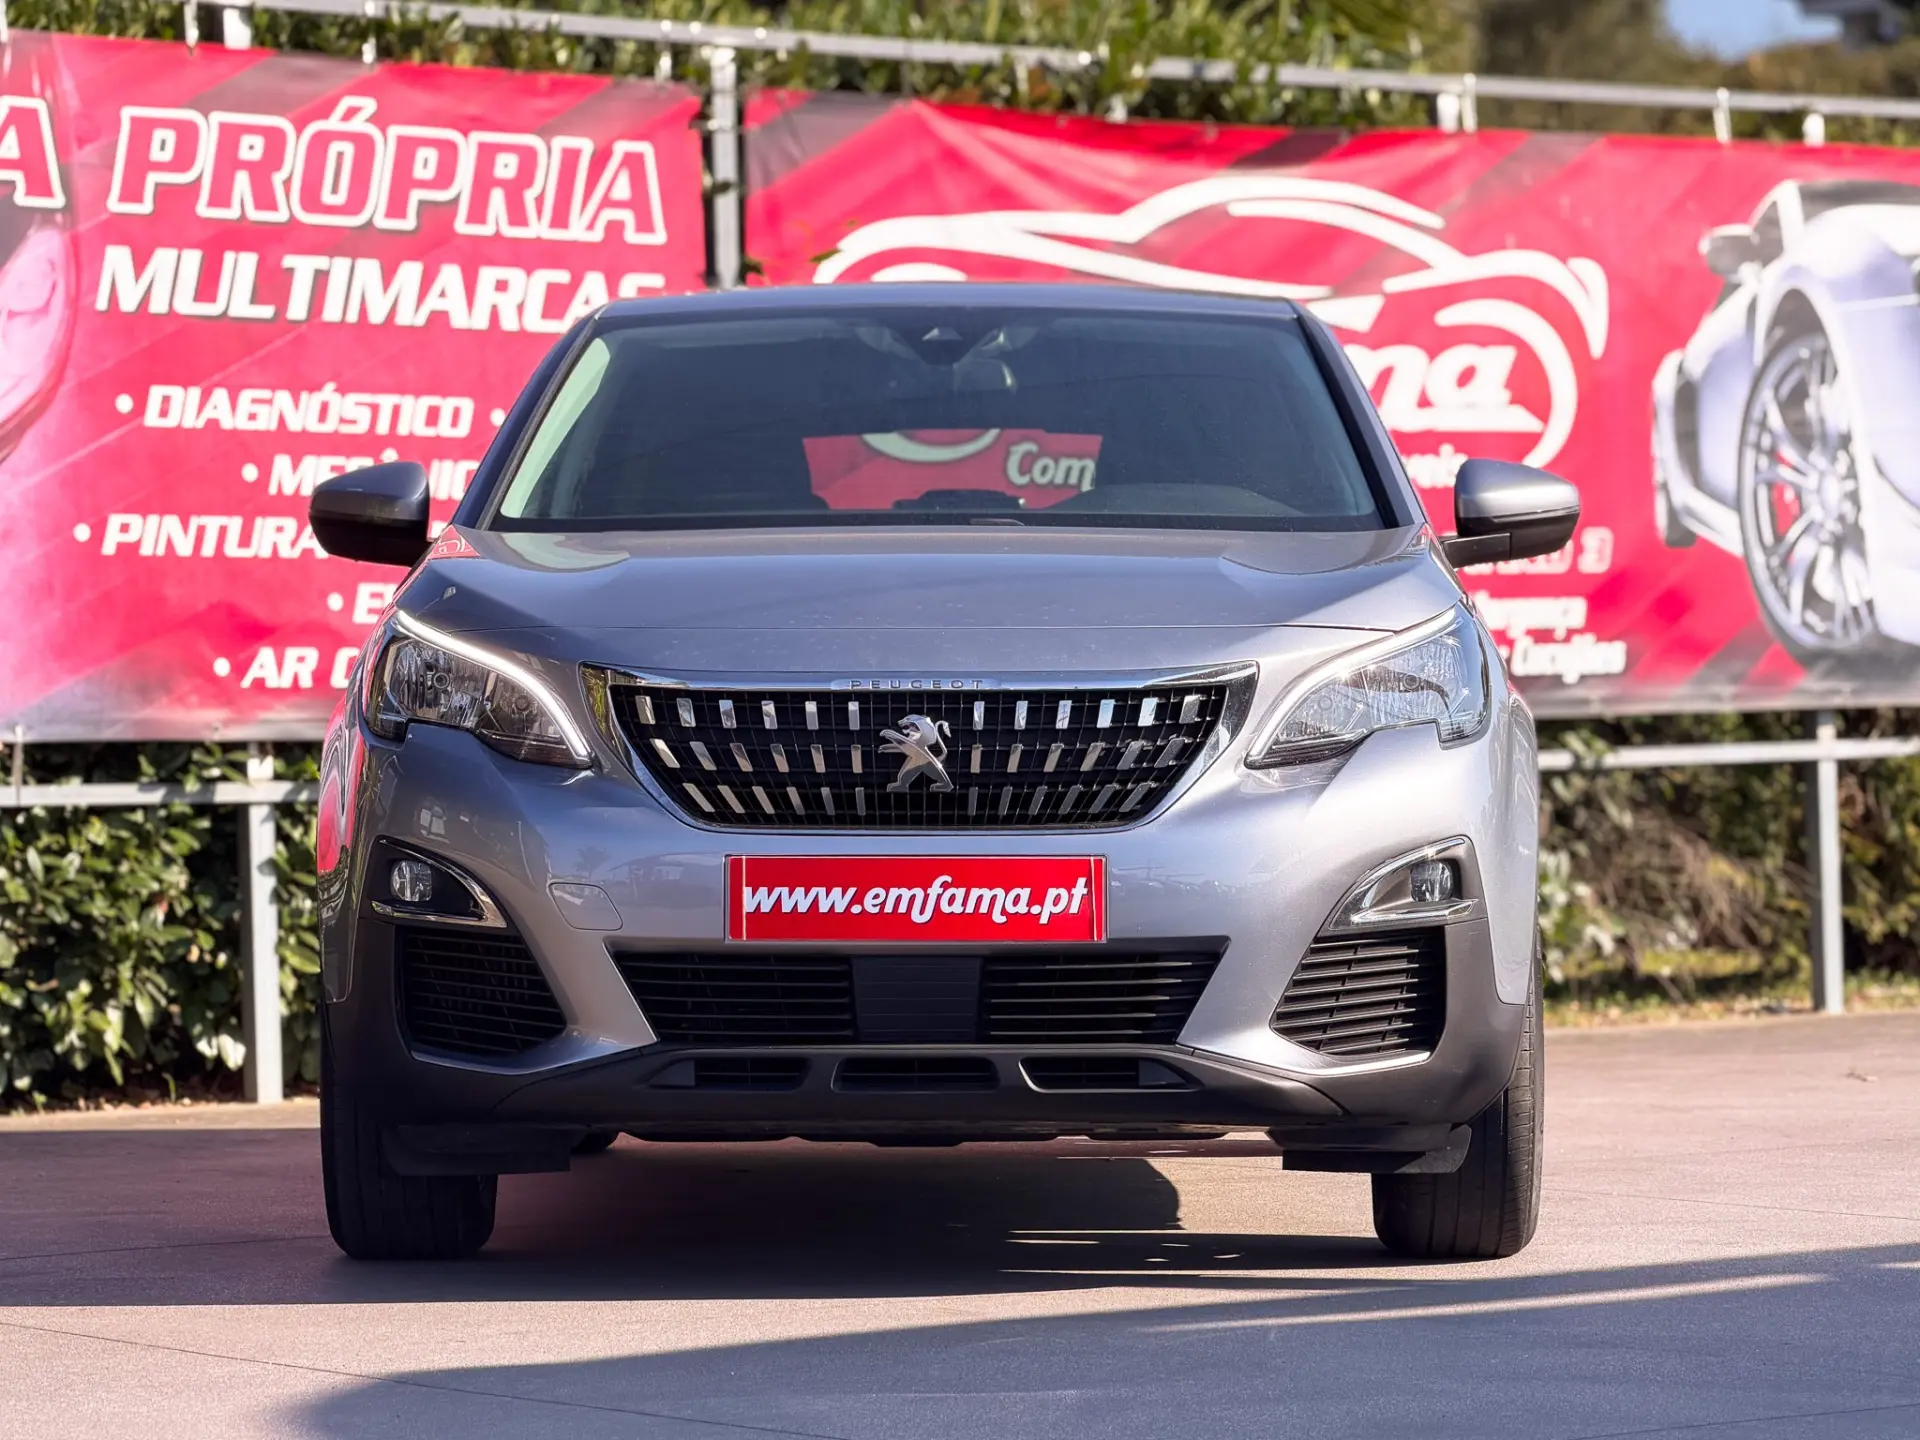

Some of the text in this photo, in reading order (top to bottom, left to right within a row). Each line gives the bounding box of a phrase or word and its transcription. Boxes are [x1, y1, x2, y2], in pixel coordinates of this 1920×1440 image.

[107, 97, 668, 246] PRÓPRIA
[144, 382, 474, 438] DIAGNÓSTICO
[240, 647, 318, 689] AR
[850, 679, 983, 690] PEUGEOT
[744, 874, 1088, 923] www.emfama.pt
